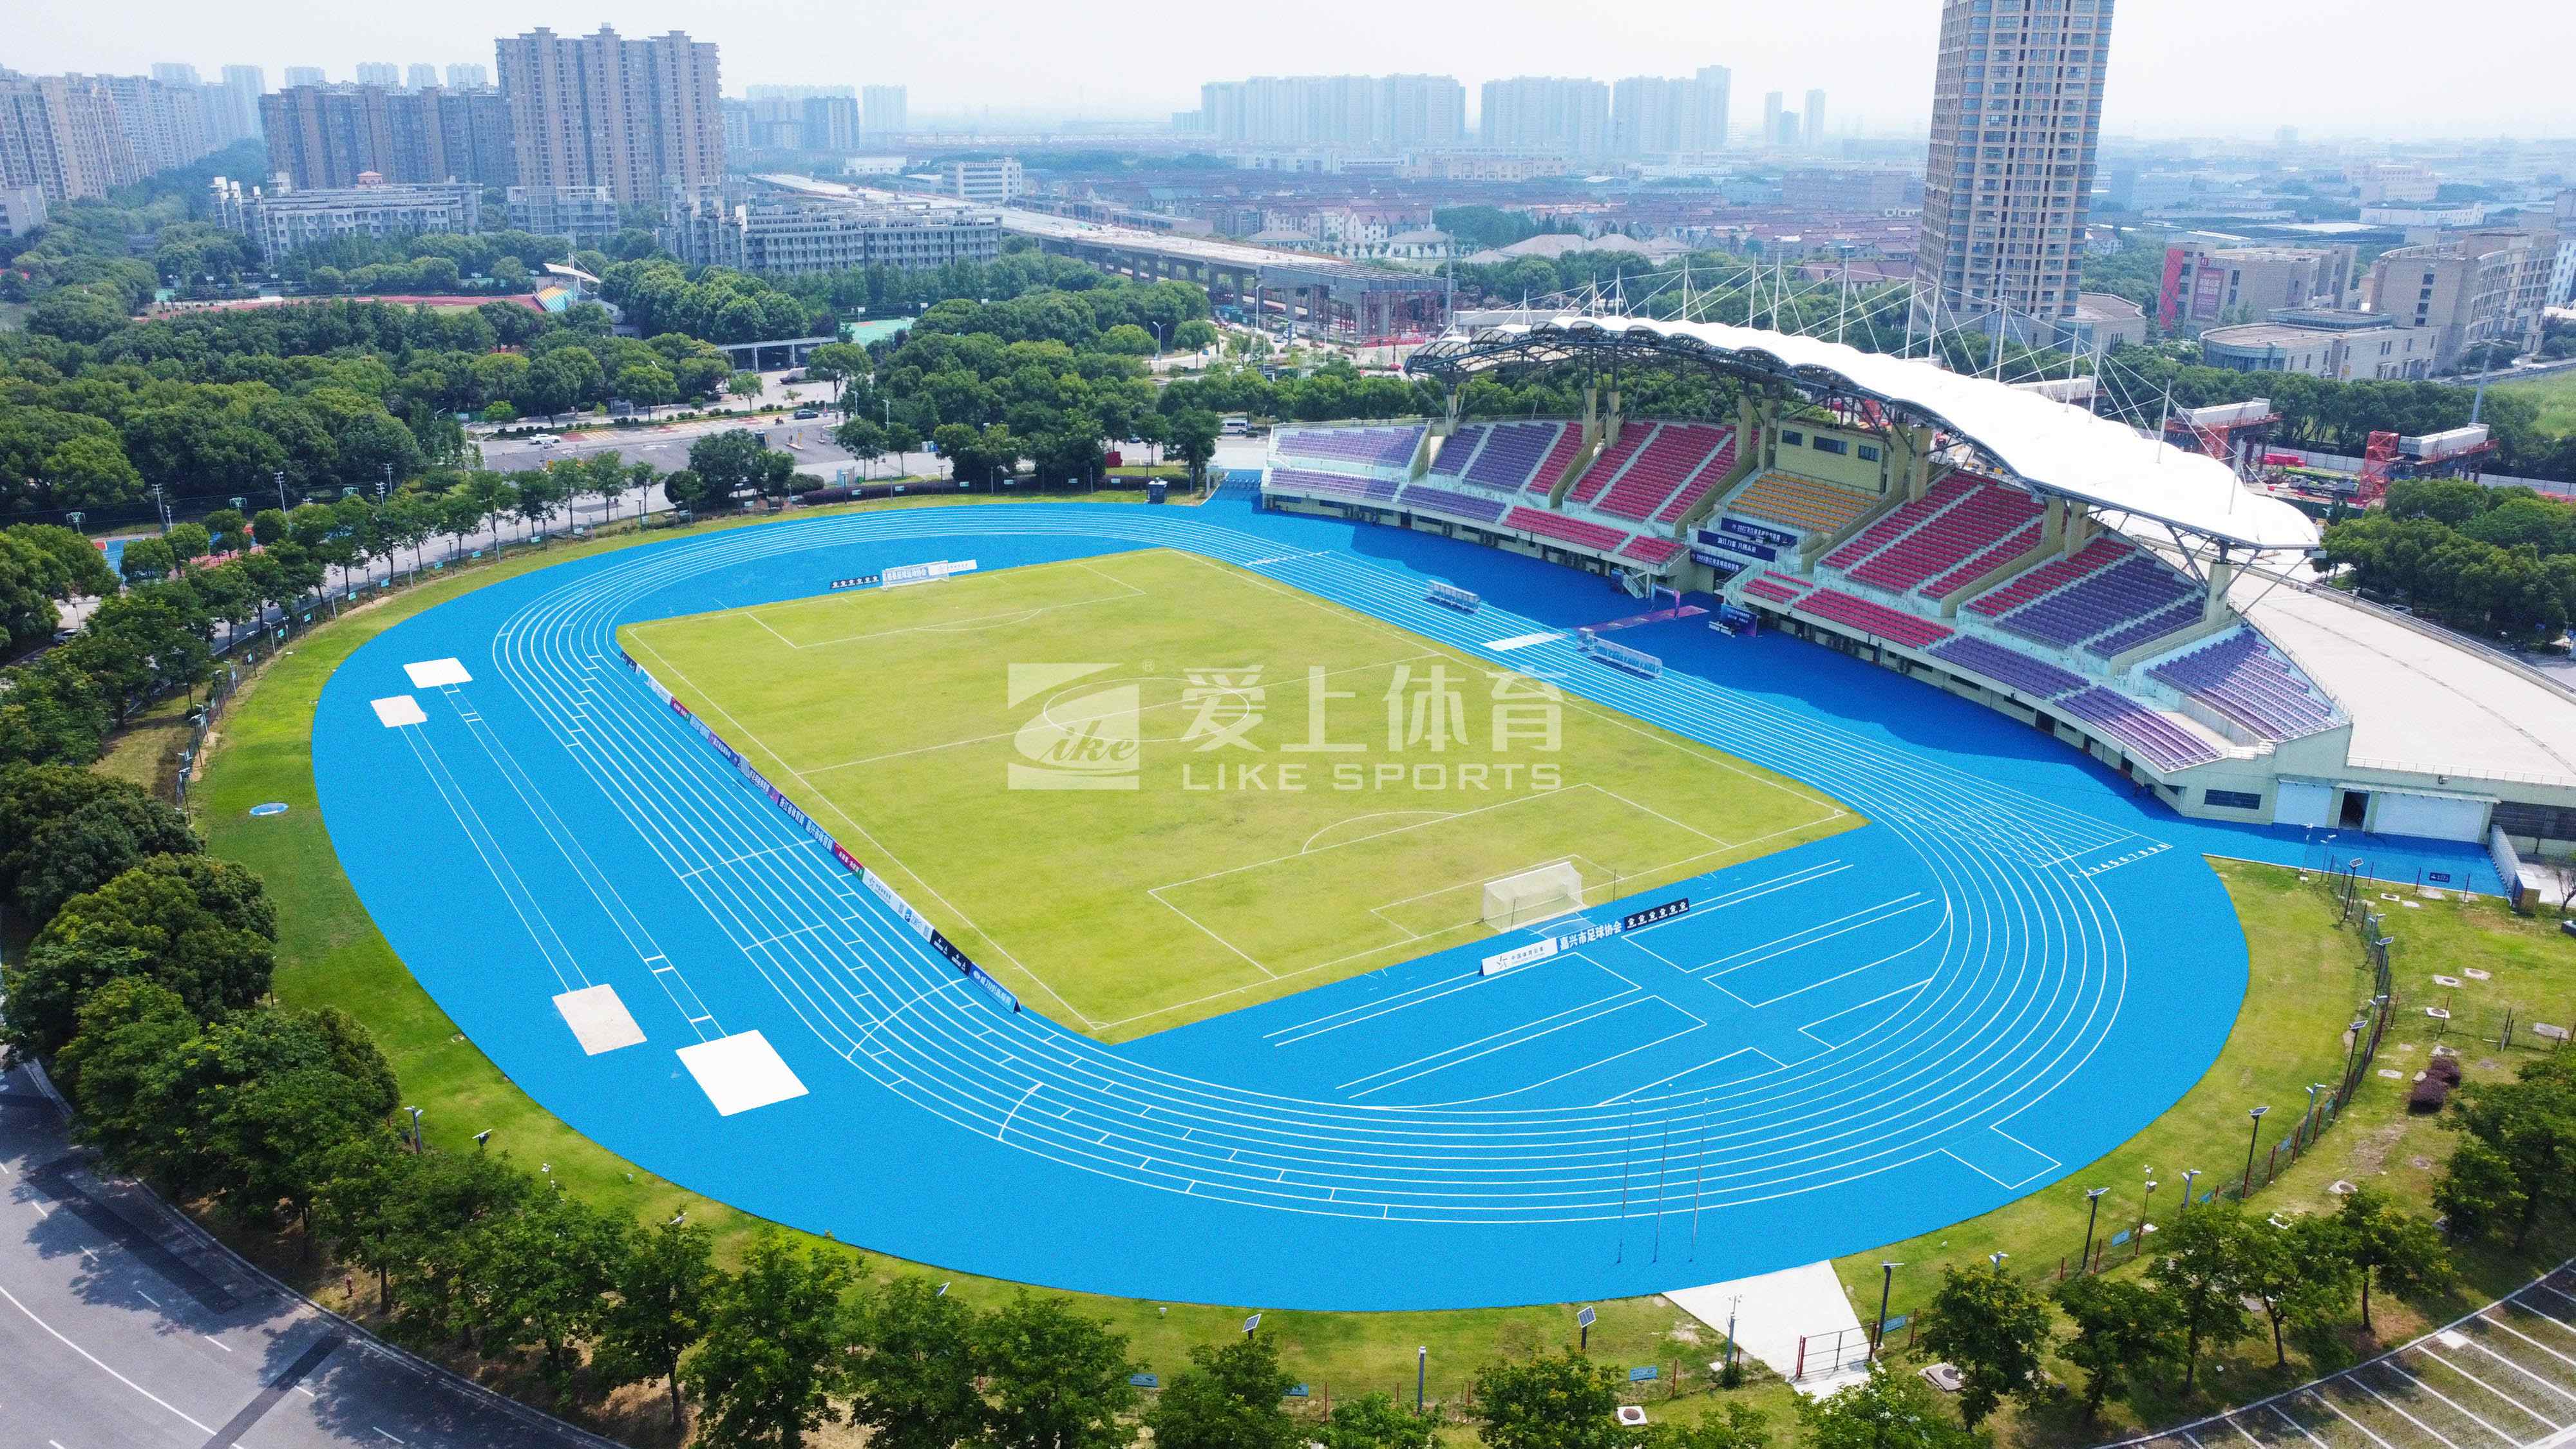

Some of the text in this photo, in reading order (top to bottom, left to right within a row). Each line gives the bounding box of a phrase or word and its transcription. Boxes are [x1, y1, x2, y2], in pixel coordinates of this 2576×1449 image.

[1560, 920, 1622, 951] 嘉兴市足球协会
